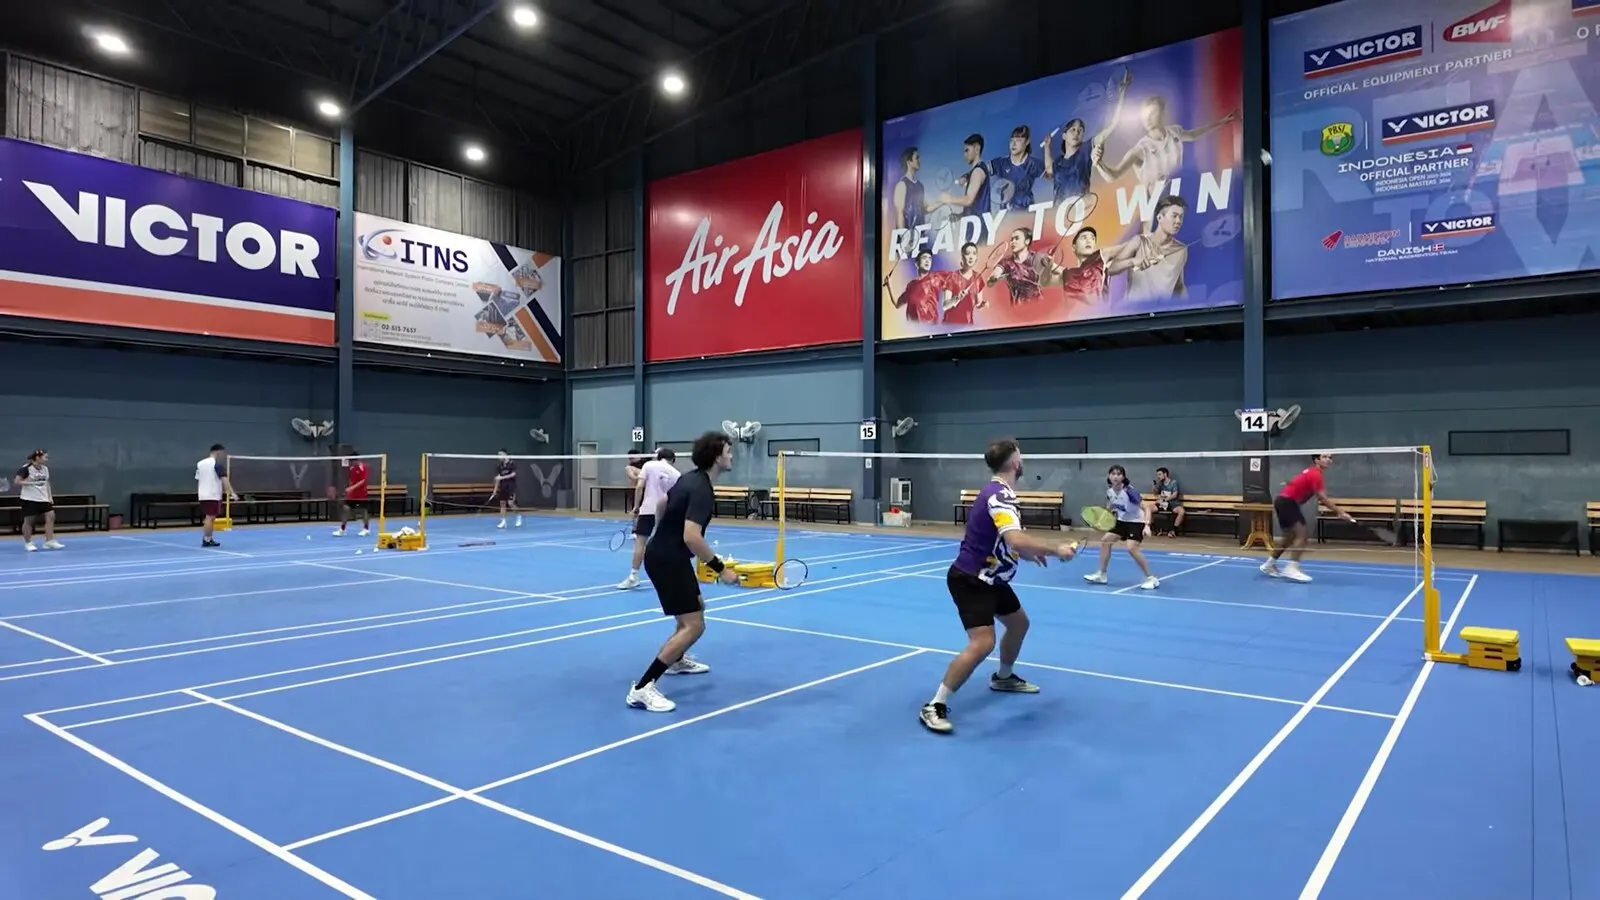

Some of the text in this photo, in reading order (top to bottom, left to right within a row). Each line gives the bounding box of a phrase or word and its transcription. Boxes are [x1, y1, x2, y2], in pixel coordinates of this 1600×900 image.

[1451, 14, 1507, 39] BWF
[1335, 31, 1416, 60] VICTOR
[1304, 49, 1512, 100] OFFICIAL EQUIPMENT PARTNER
[1412, 104, 1489, 129] VICTOR
[1338, 147, 1454, 173] INDONESIA
[1360, 157, 1469, 182] OFFICIAL PARTNER
[22, 180, 320, 279] VICTOR
[1028, 195, 1086, 242] TO
[1442, 216, 1492, 231] VICTOR
[400, 238, 468, 273] ITNS
[1377, 246, 1431, 258] DANISH
[862, 427, 874, 438] 15
[1245, 416, 1264, 429] 14
[633, 431, 642, 440] 16
